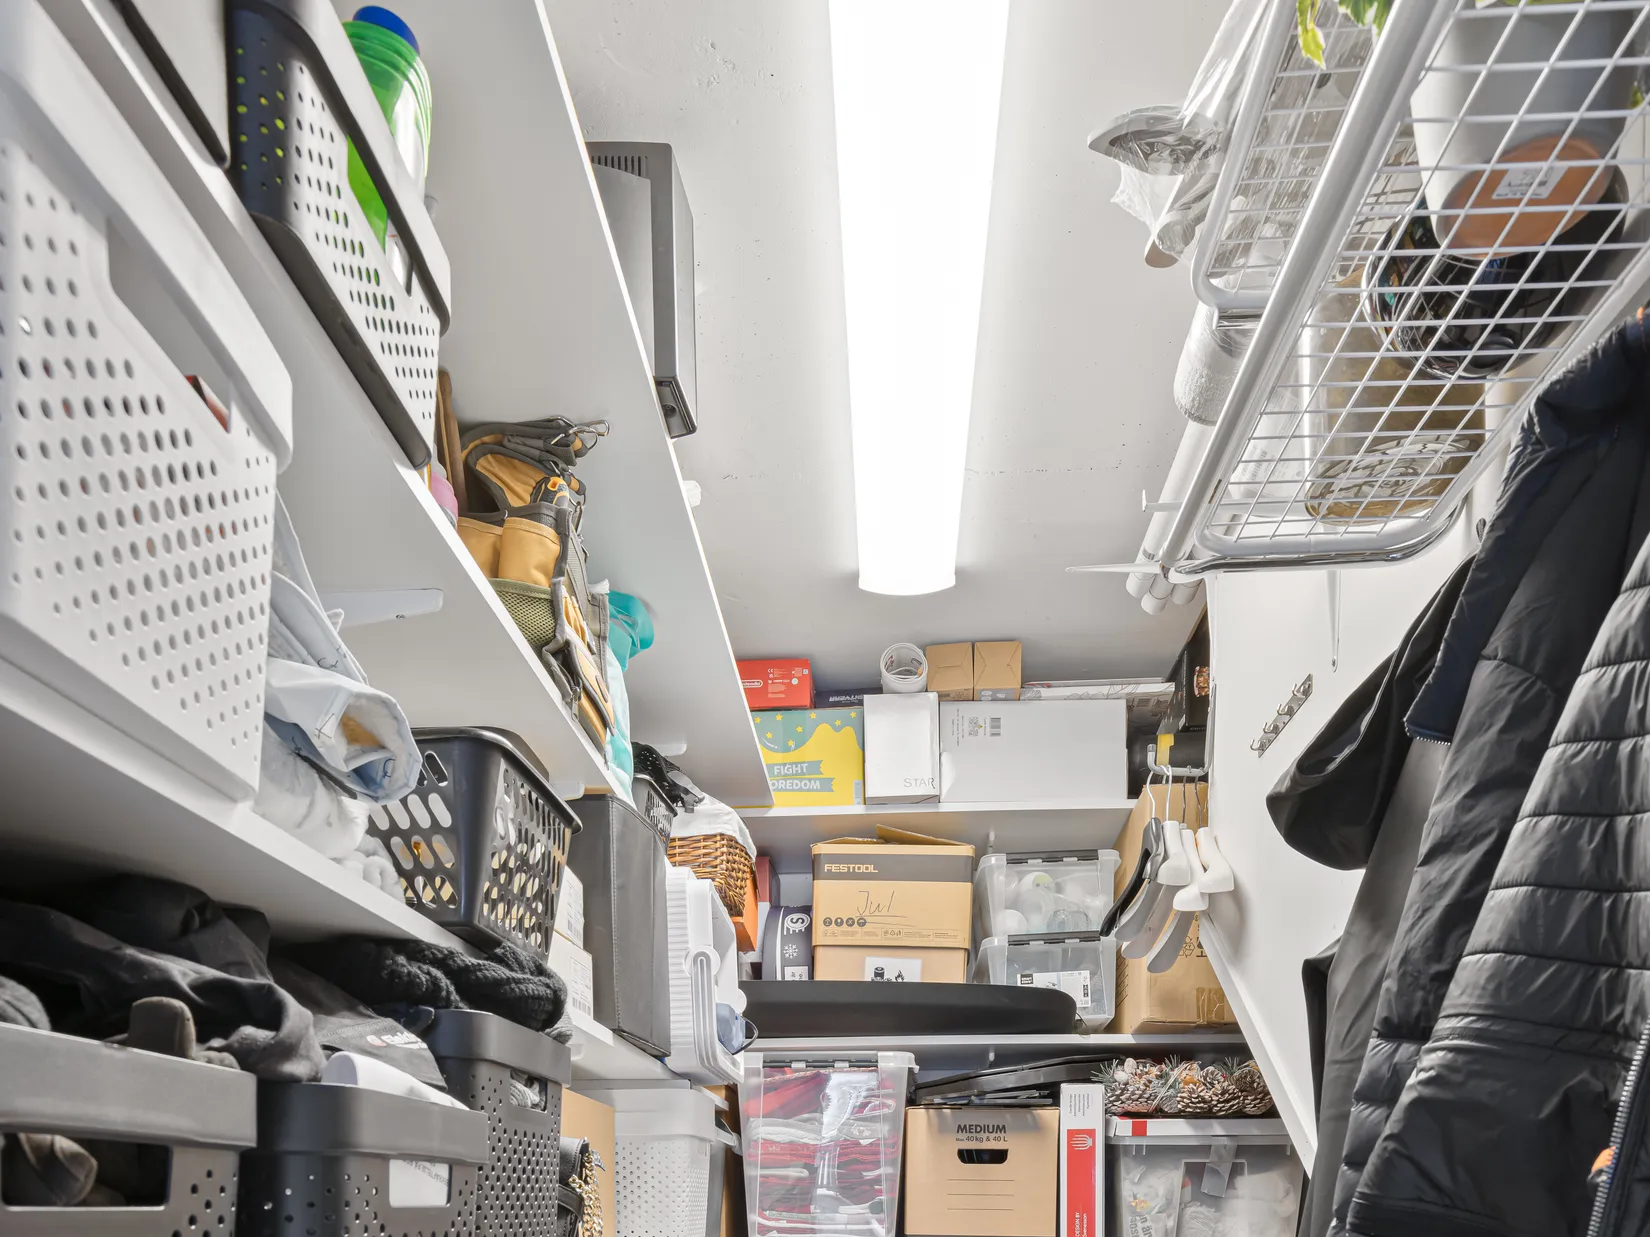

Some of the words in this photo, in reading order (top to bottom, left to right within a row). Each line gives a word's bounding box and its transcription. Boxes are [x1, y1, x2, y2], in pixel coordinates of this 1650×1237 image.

[774, 764, 808, 775] FIGHT
[824, 864, 879, 873] FESTOOL
[956, 1124, 1007, 1134] MEDIUM
